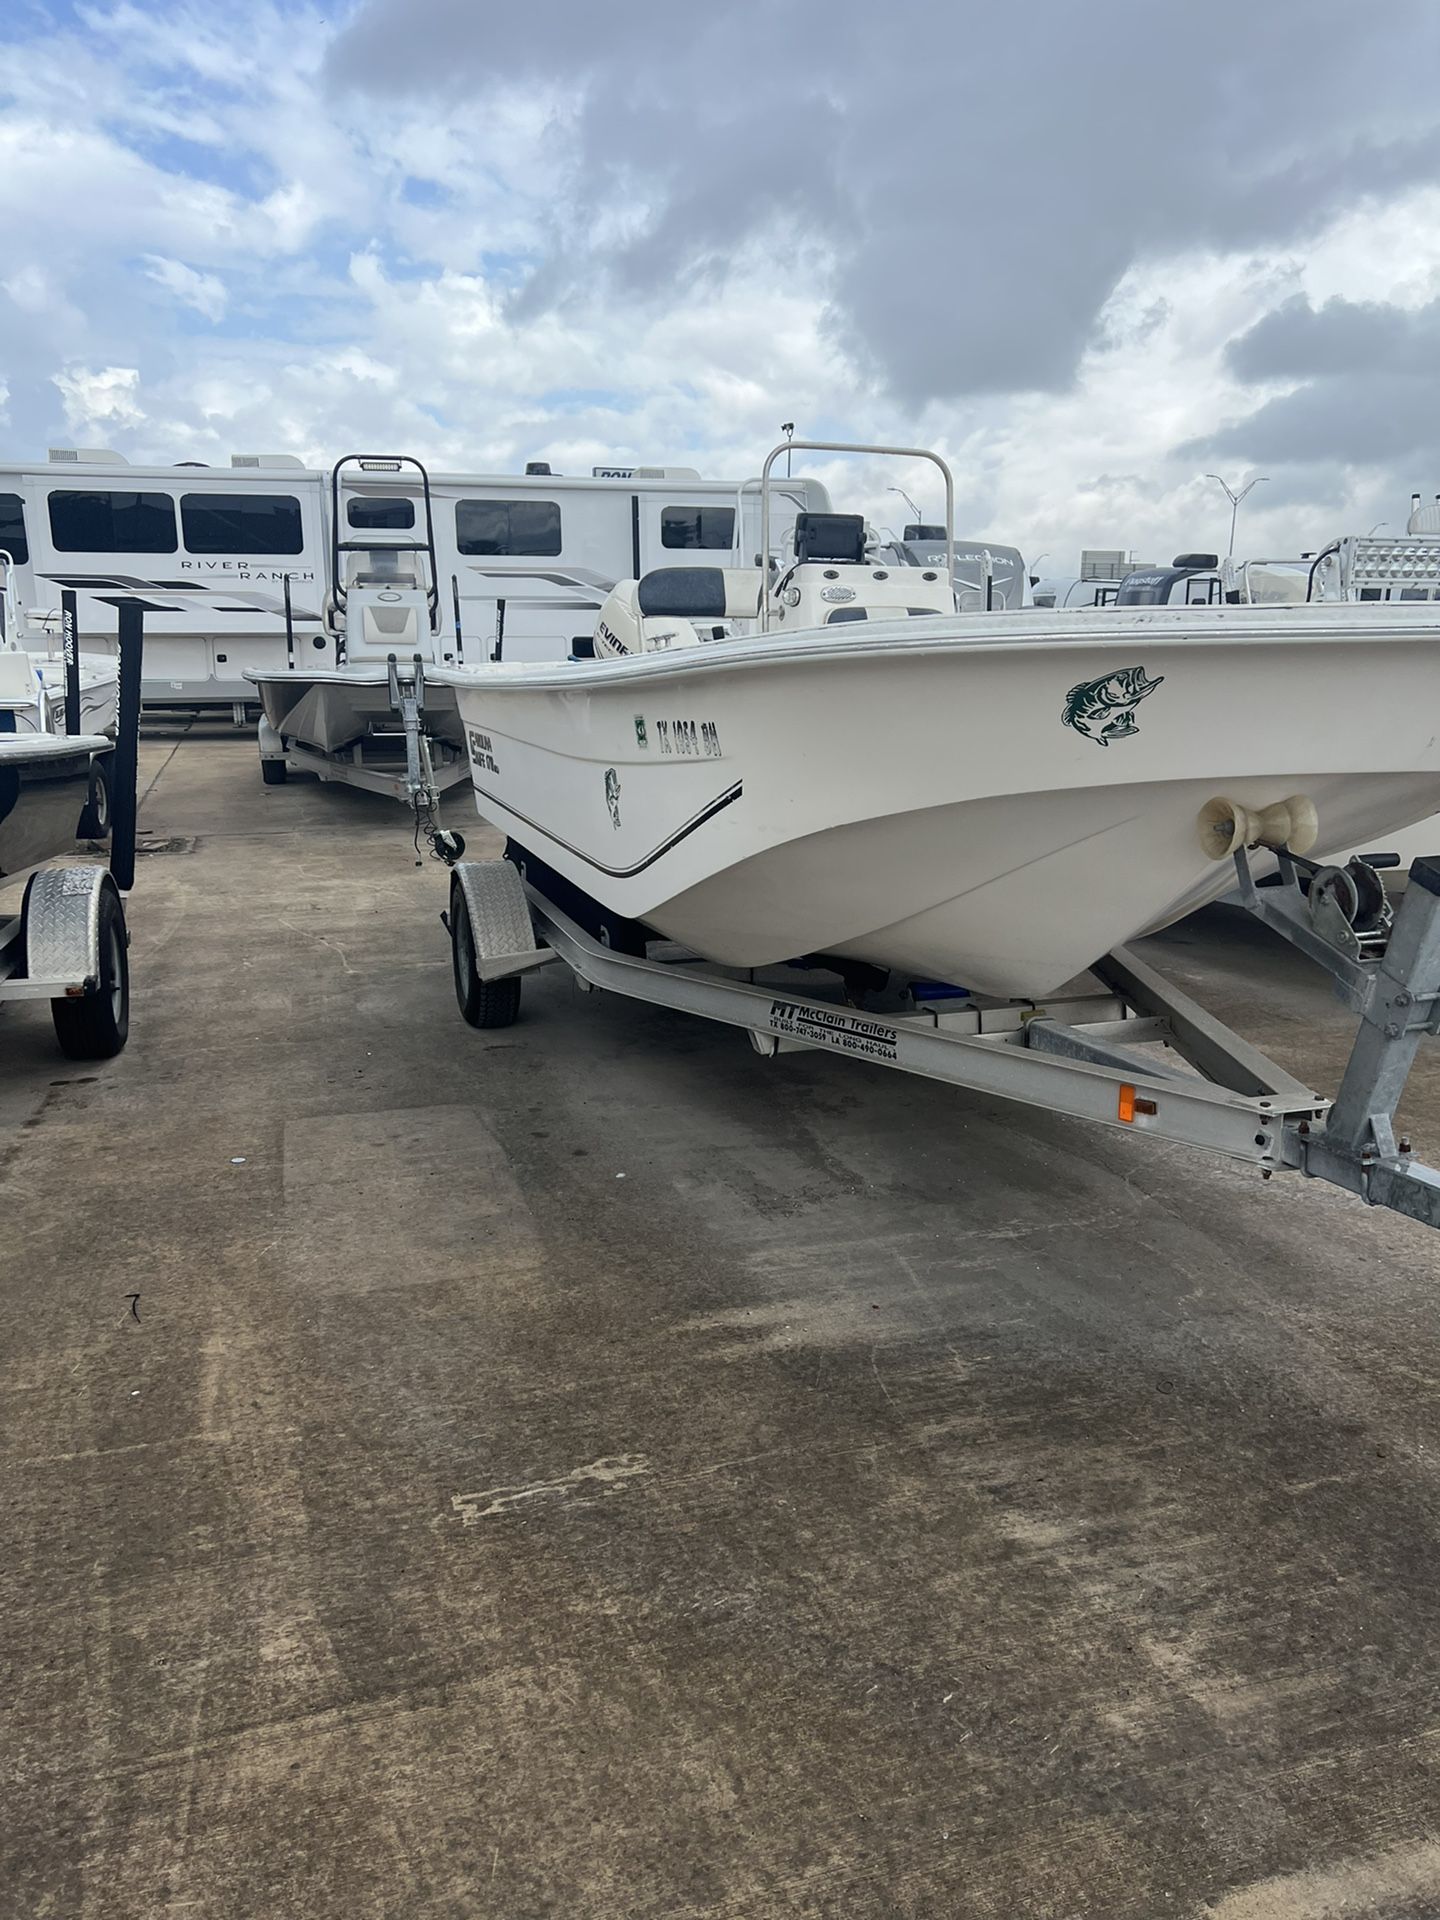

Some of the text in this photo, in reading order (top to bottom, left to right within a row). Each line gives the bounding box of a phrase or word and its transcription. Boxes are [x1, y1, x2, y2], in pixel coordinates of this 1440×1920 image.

[181, 561, 249, 569] RIVER
[240, 572, 314, 580] RANCH
[799, 1006, 897, 1040] McClain Trailers
